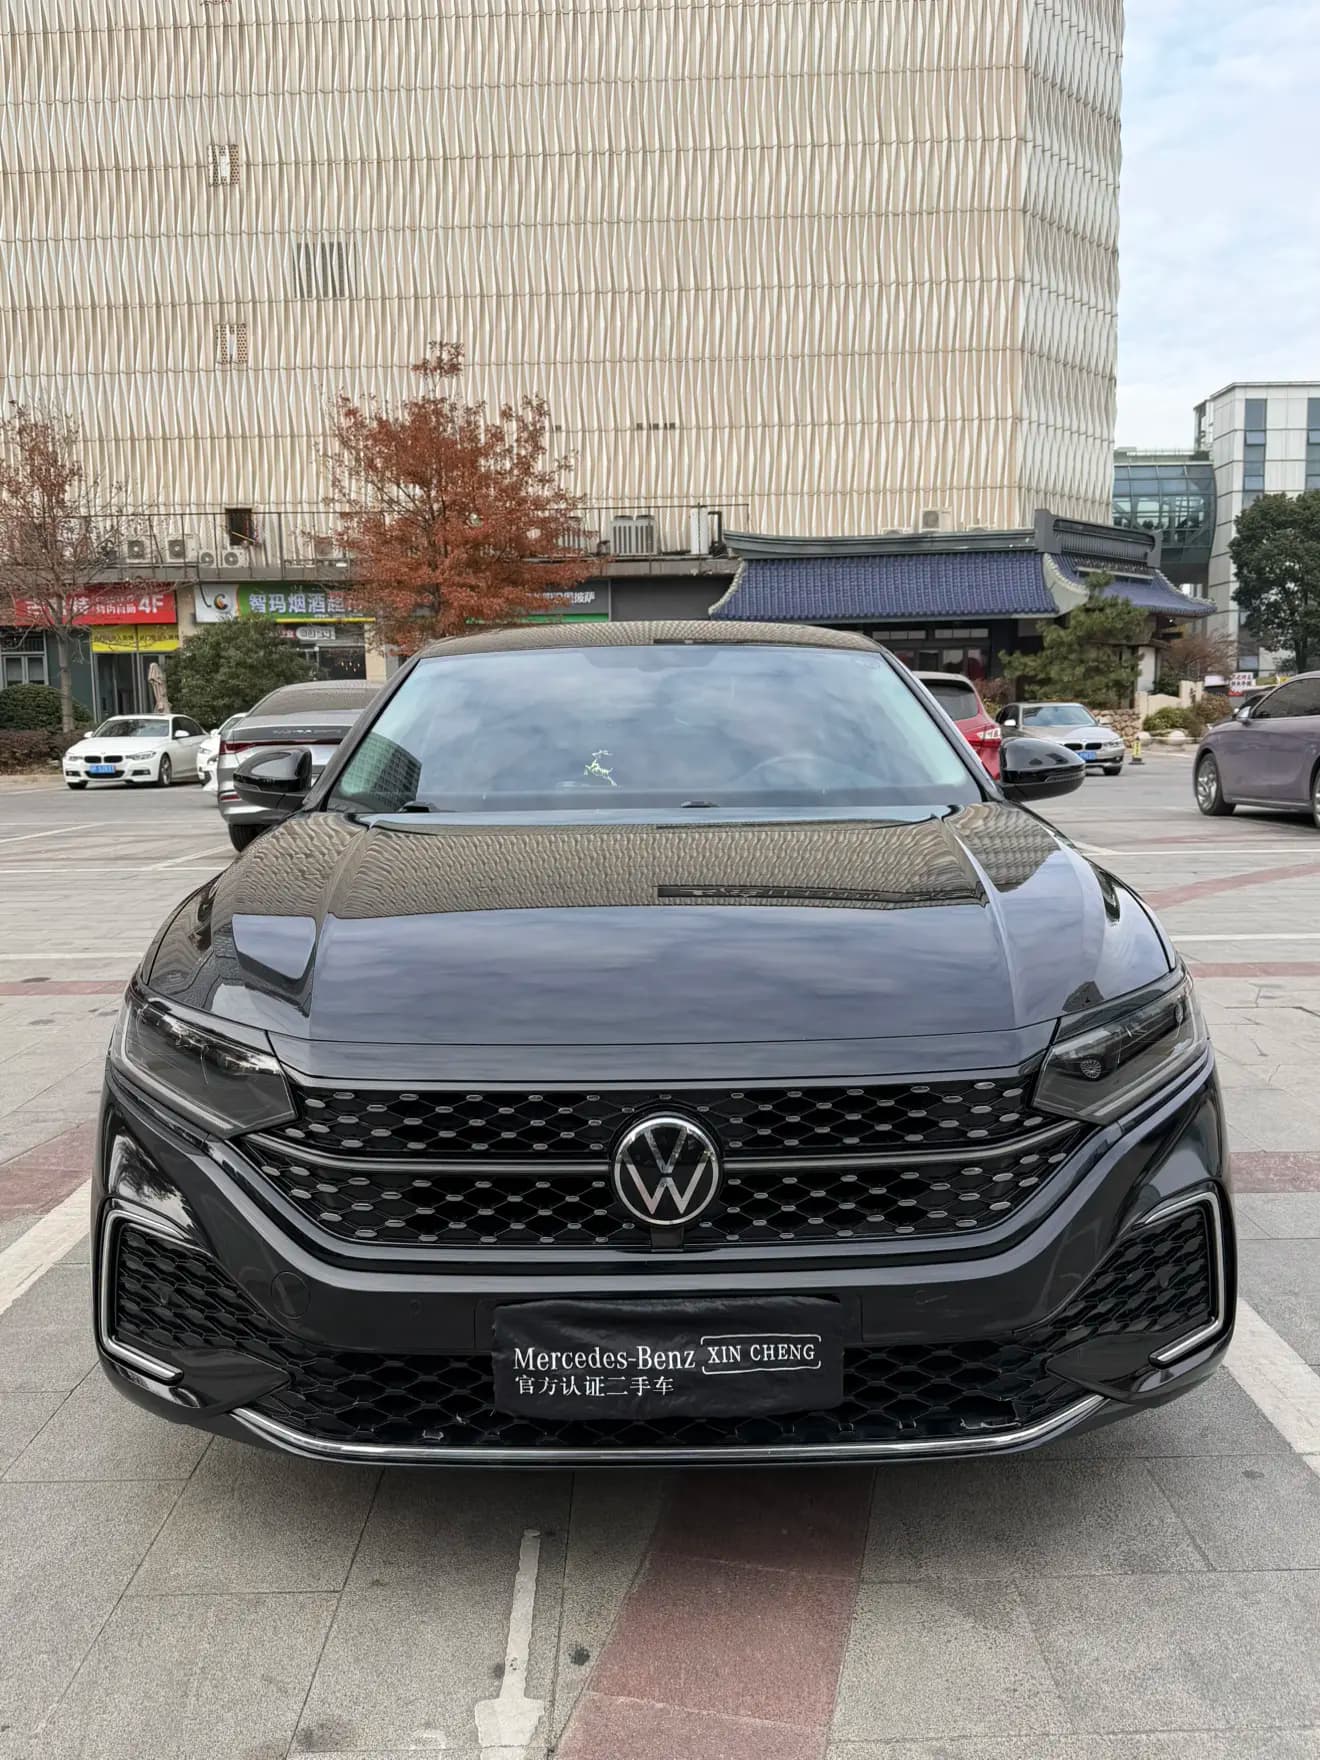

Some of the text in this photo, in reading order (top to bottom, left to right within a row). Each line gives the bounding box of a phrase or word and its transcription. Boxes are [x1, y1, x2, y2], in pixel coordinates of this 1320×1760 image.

[513, 1343, 815, 1371] Mercedes-Benz XIN CHENG
[515, 1375, 674, 1397] 官方认证二手车
